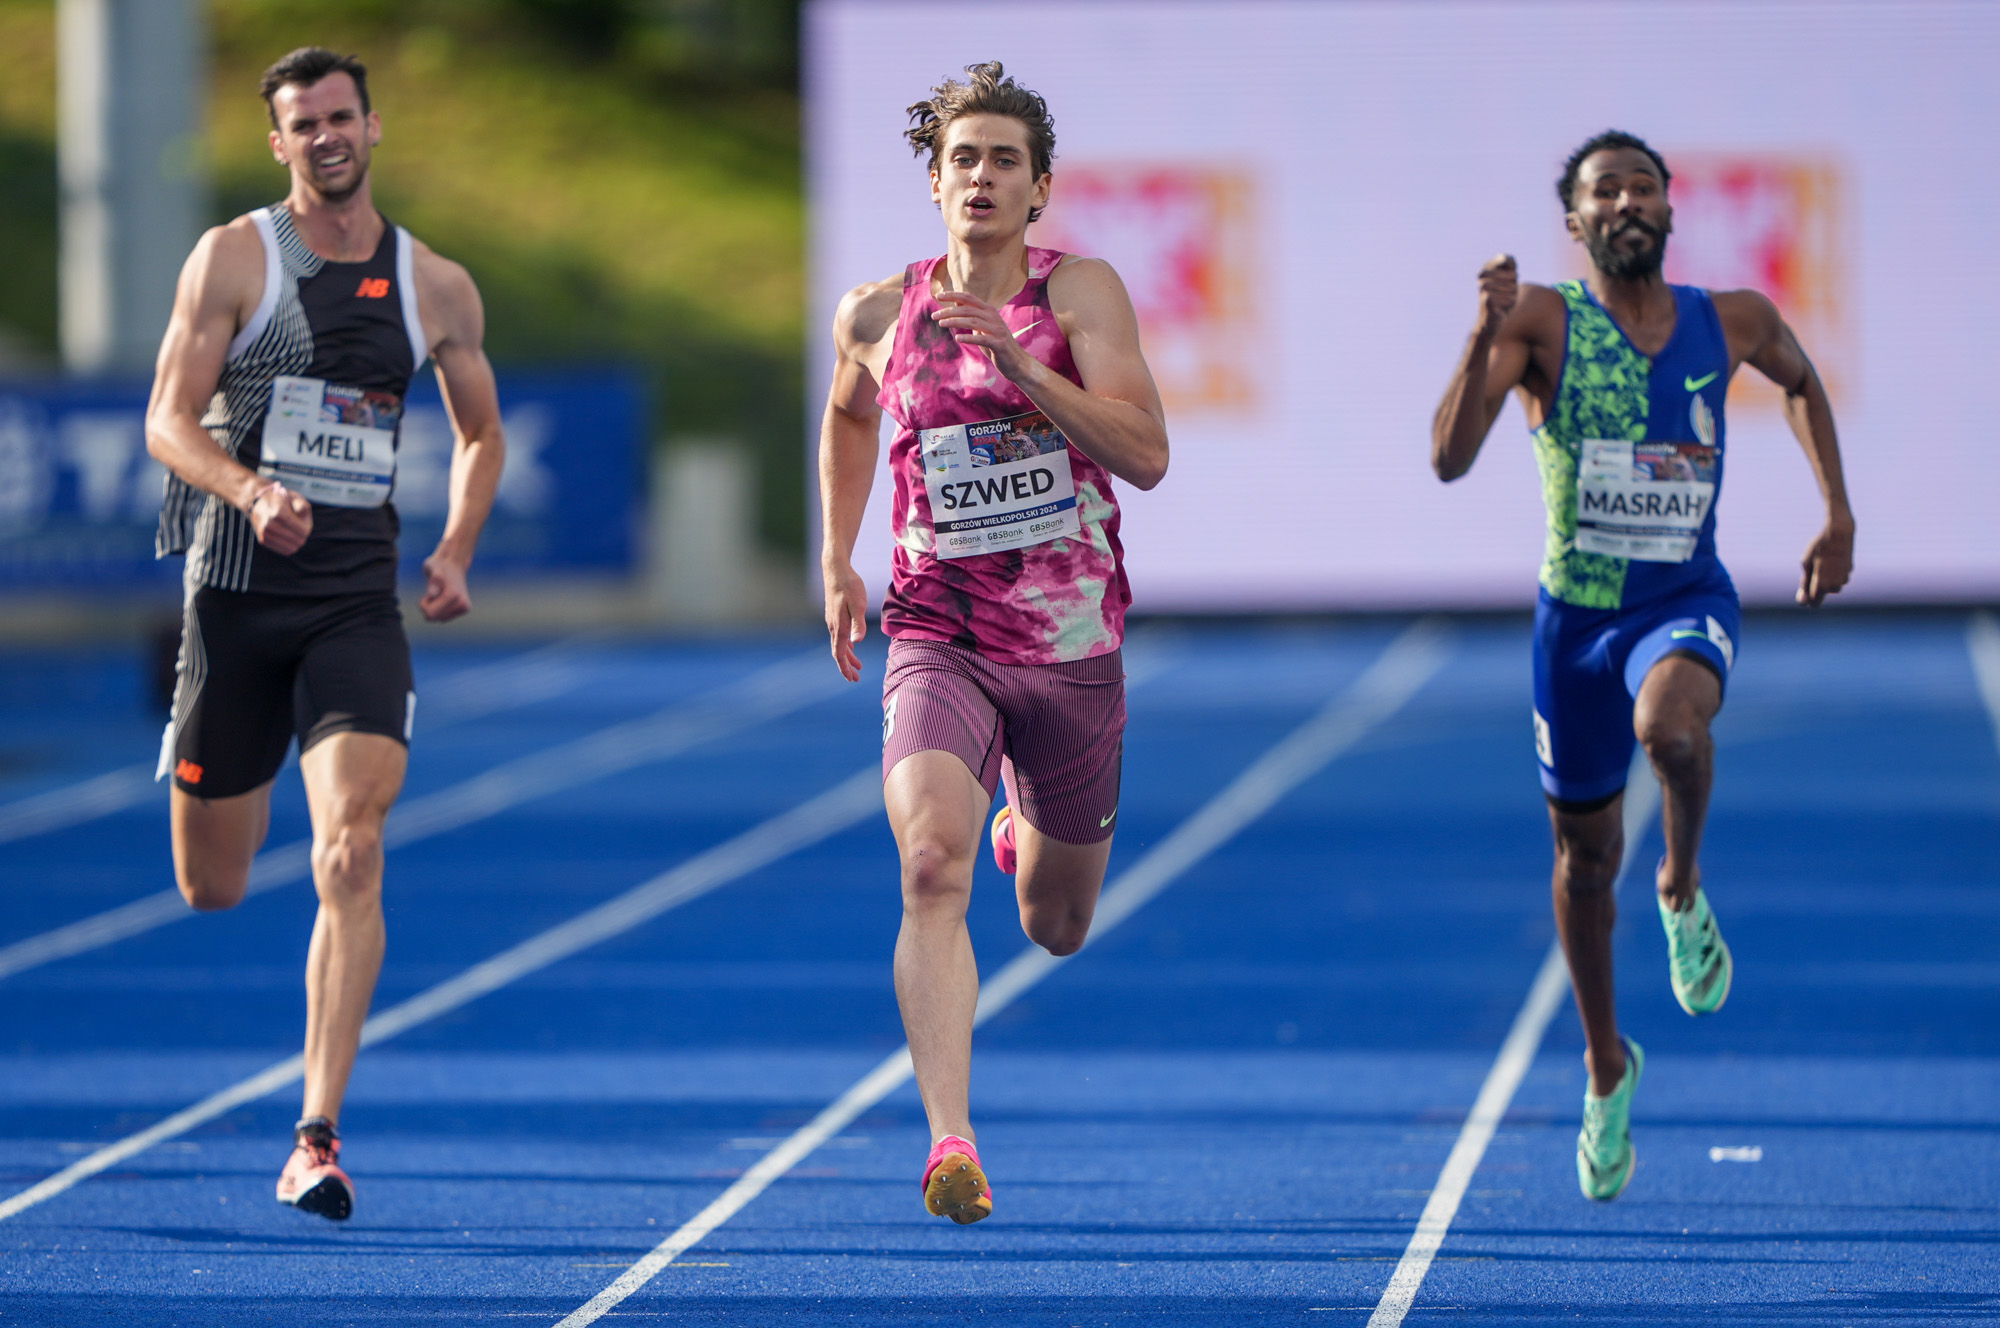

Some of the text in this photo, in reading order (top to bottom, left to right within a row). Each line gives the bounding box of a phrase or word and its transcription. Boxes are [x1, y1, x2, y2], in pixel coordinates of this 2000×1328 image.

[354, 277, 390, 298] NB
[969, 422, 1011, 437] GORZÓW
[298, 430, 364, 462] MELI
[971, 436, 998, 447] 2024
[940, 468, 1054, 510] SZWED
[950, 504, 1058, 531] GORZÓW WIELKOPOLSKI 2024
[1029, 517, 1064, 533] GBSBank
[987, 528, 1024, 541] GBSBank
